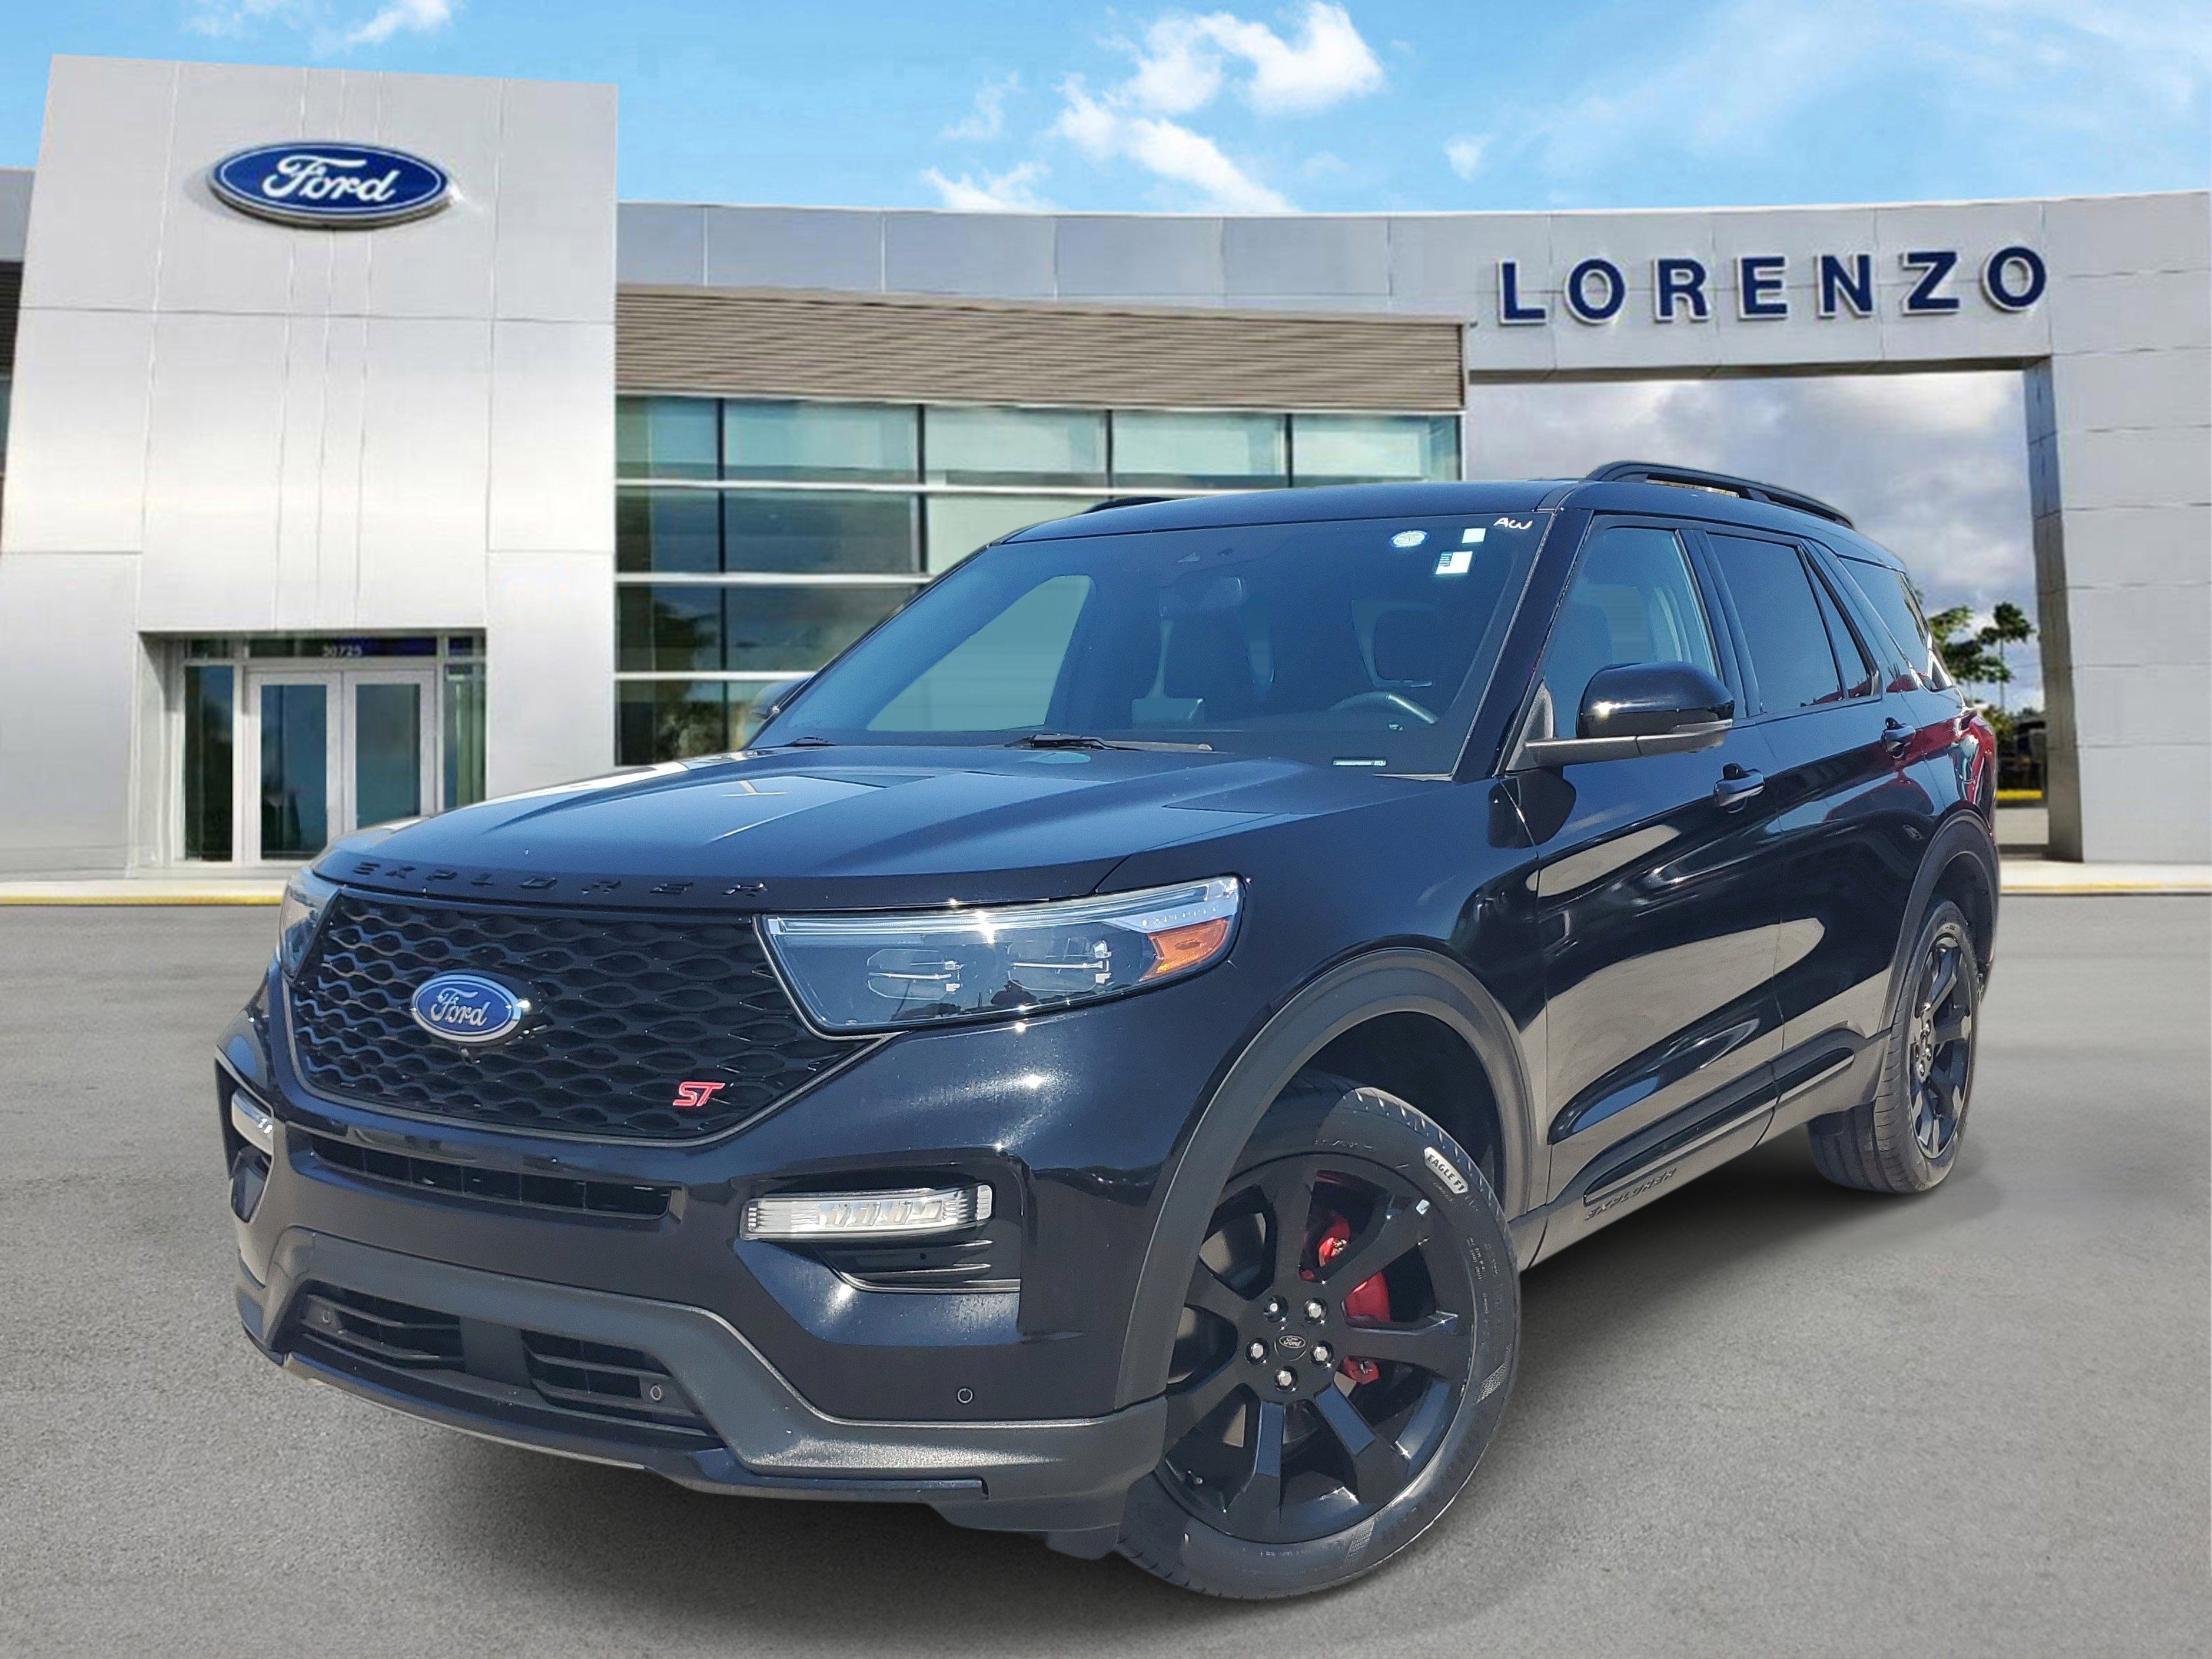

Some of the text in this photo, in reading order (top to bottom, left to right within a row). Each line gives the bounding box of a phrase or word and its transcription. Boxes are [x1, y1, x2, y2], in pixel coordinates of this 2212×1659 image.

[262, 154, 400, 202] Ford
[1498, 246, 2047, 325] LORENZO
[353, 861, 768, 897] EXPLORER
[430, 986, 491, 1026] Ford
[672, 1081, 726, 1107] ST
[1427, 1154, 1465, 1191] EAGLE F1
[1584, 1167, 1678, 1221] EXPLORER
[1283, 1336, 1303, 1347] Ford
